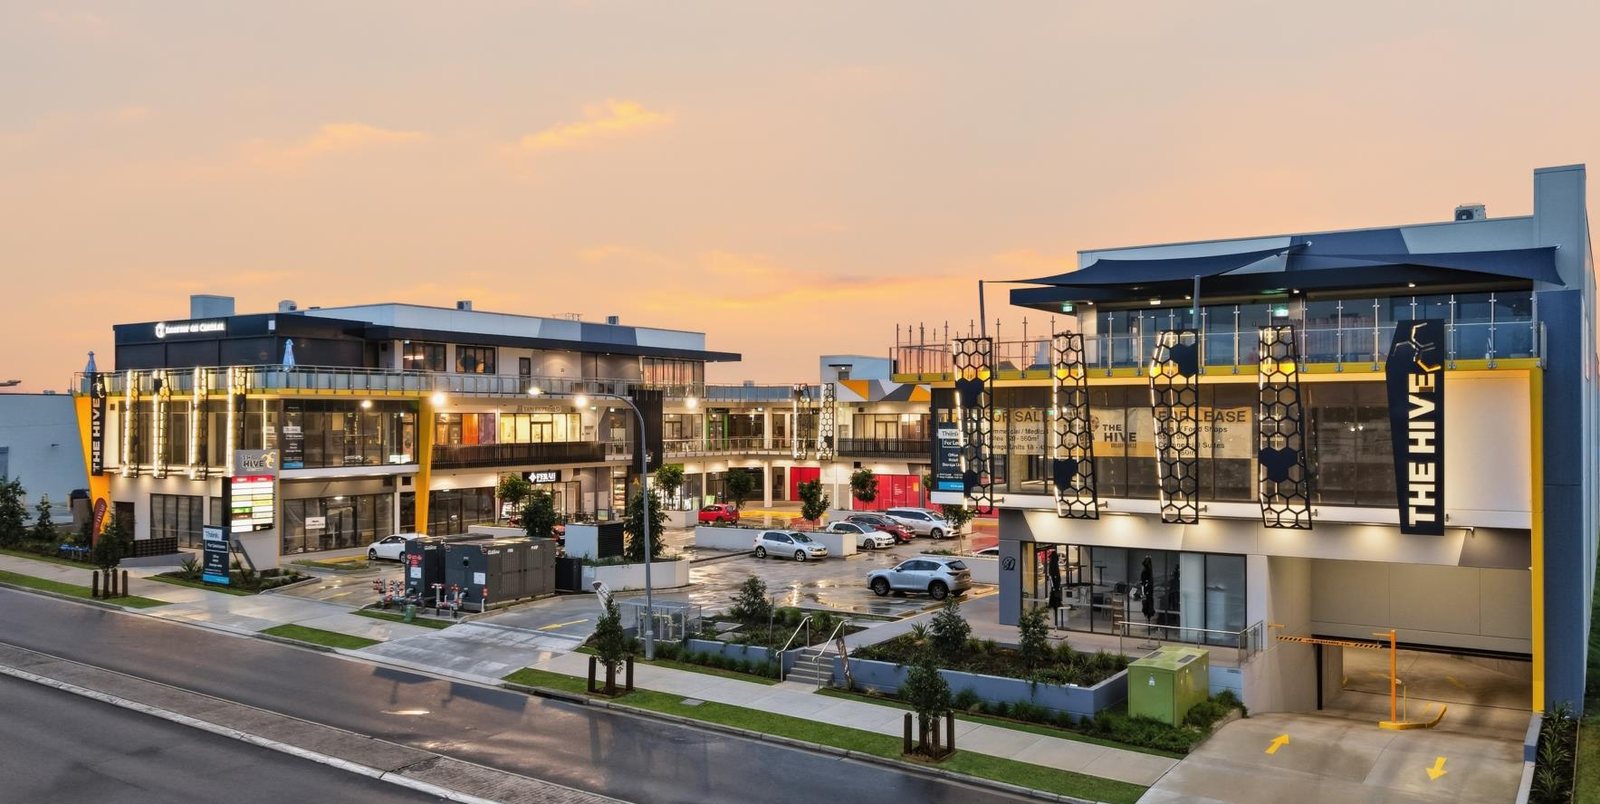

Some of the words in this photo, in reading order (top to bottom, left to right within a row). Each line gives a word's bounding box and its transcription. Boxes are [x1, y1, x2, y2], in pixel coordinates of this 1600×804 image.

[92, 398, 101, 437] HIVE
[1102, 424, 1122, 432] THE
[1408, 373, 1435, 454] HIVE
[1104, 432, 1137, 443] HIVE
[1202, 441, 1225, 449] Sutes
[92, 441, 101, 473] THE
[1408, 462, 1435, 527] THE
